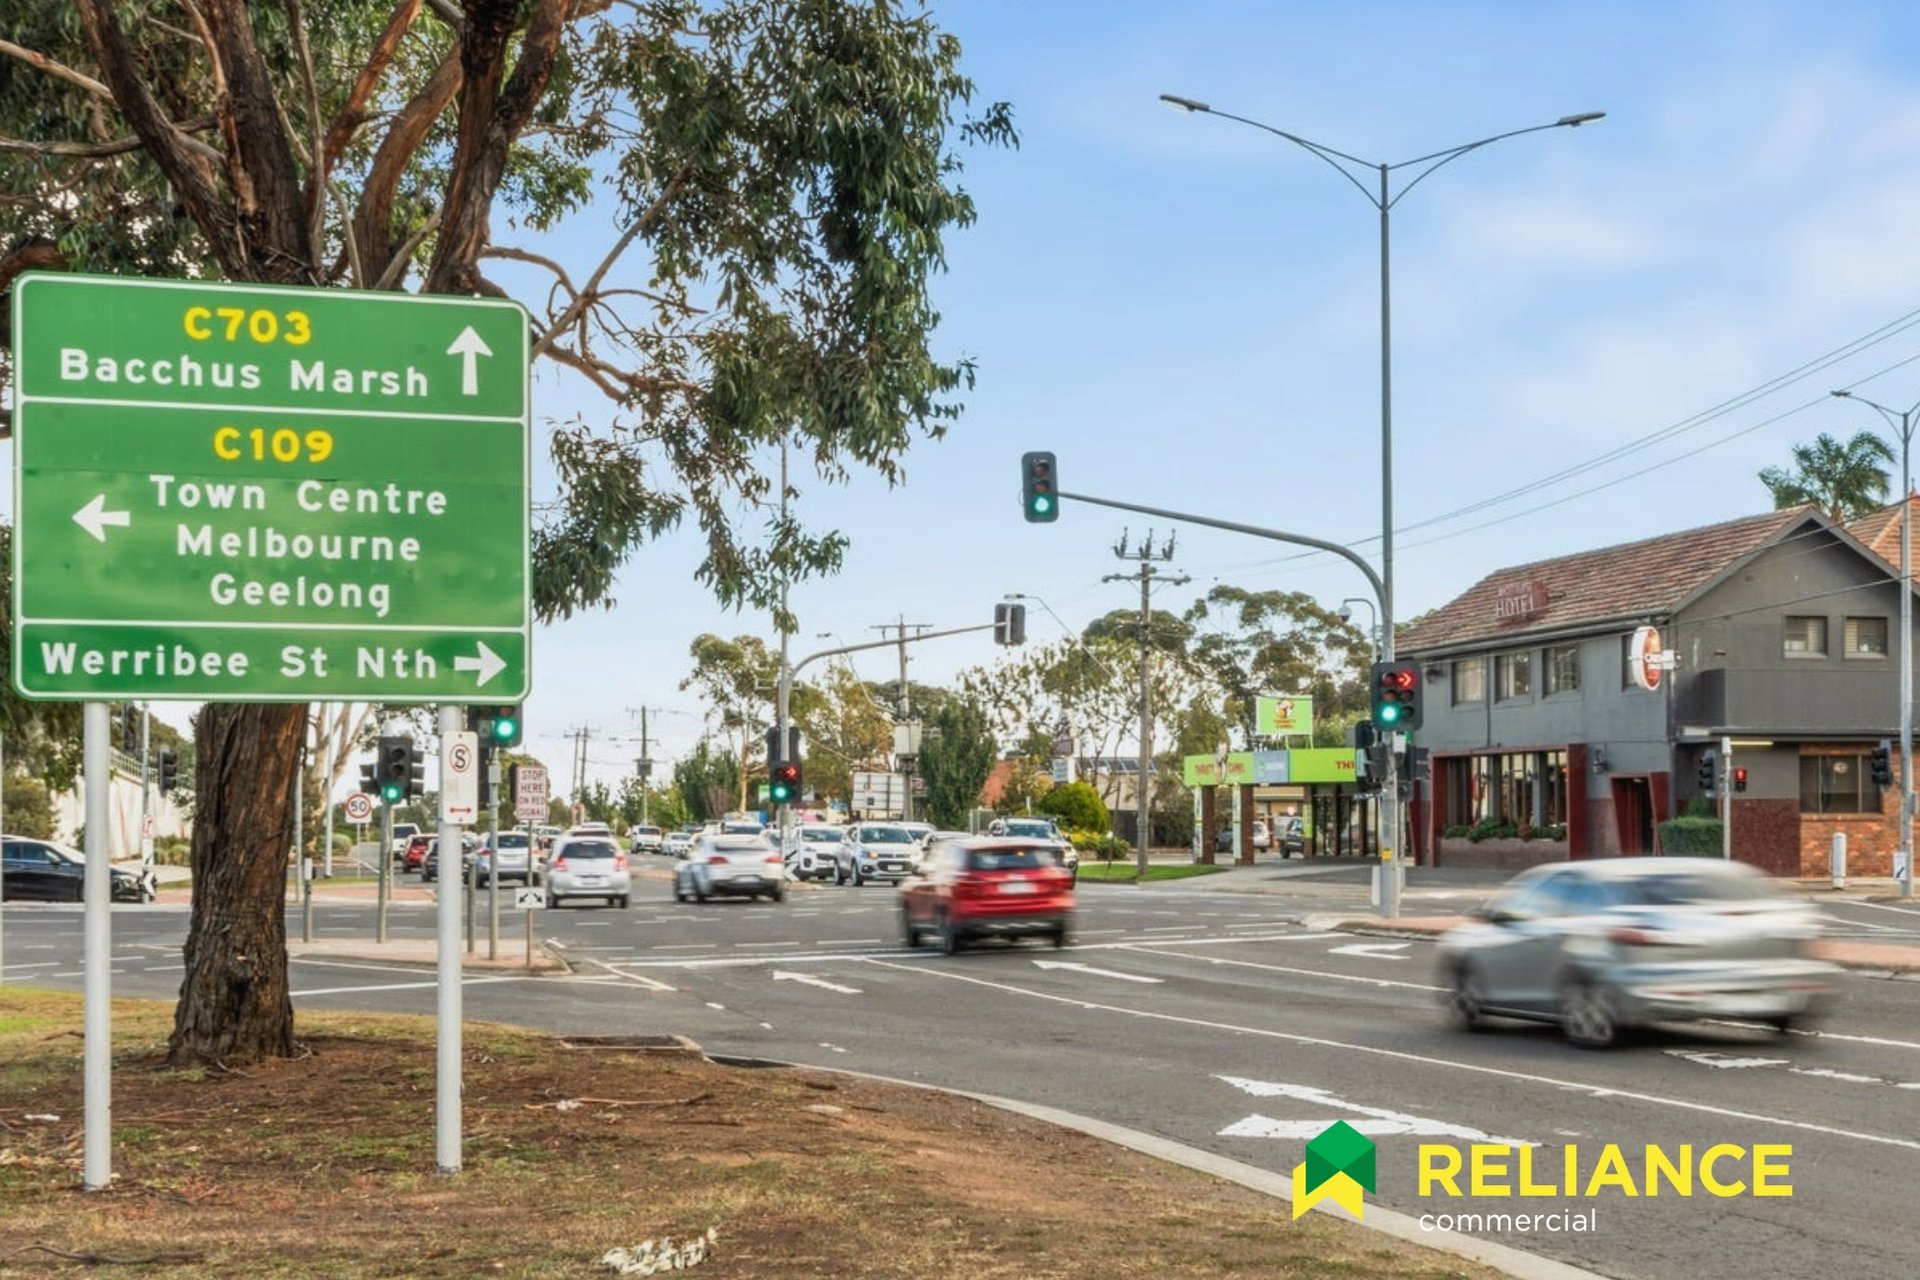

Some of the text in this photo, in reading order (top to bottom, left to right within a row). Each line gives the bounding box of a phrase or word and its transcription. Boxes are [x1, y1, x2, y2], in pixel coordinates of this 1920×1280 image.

[183, 306, 312, 346] C703
[60, 348, 428, 397] Bacchus Marsh
[213, 426, 334, 463] C109
[149, 474, 448, 515] Town Centre
[177, 523, 421, 562] Melbourne
[210, 572, 390, 618] Geelong
[41, 642, 437, 679] Werribee St Nth
[521, 769, 545, 780] STOP
[521, 782, 545, 793] HERE
[351, 800, 367, 812] 50
